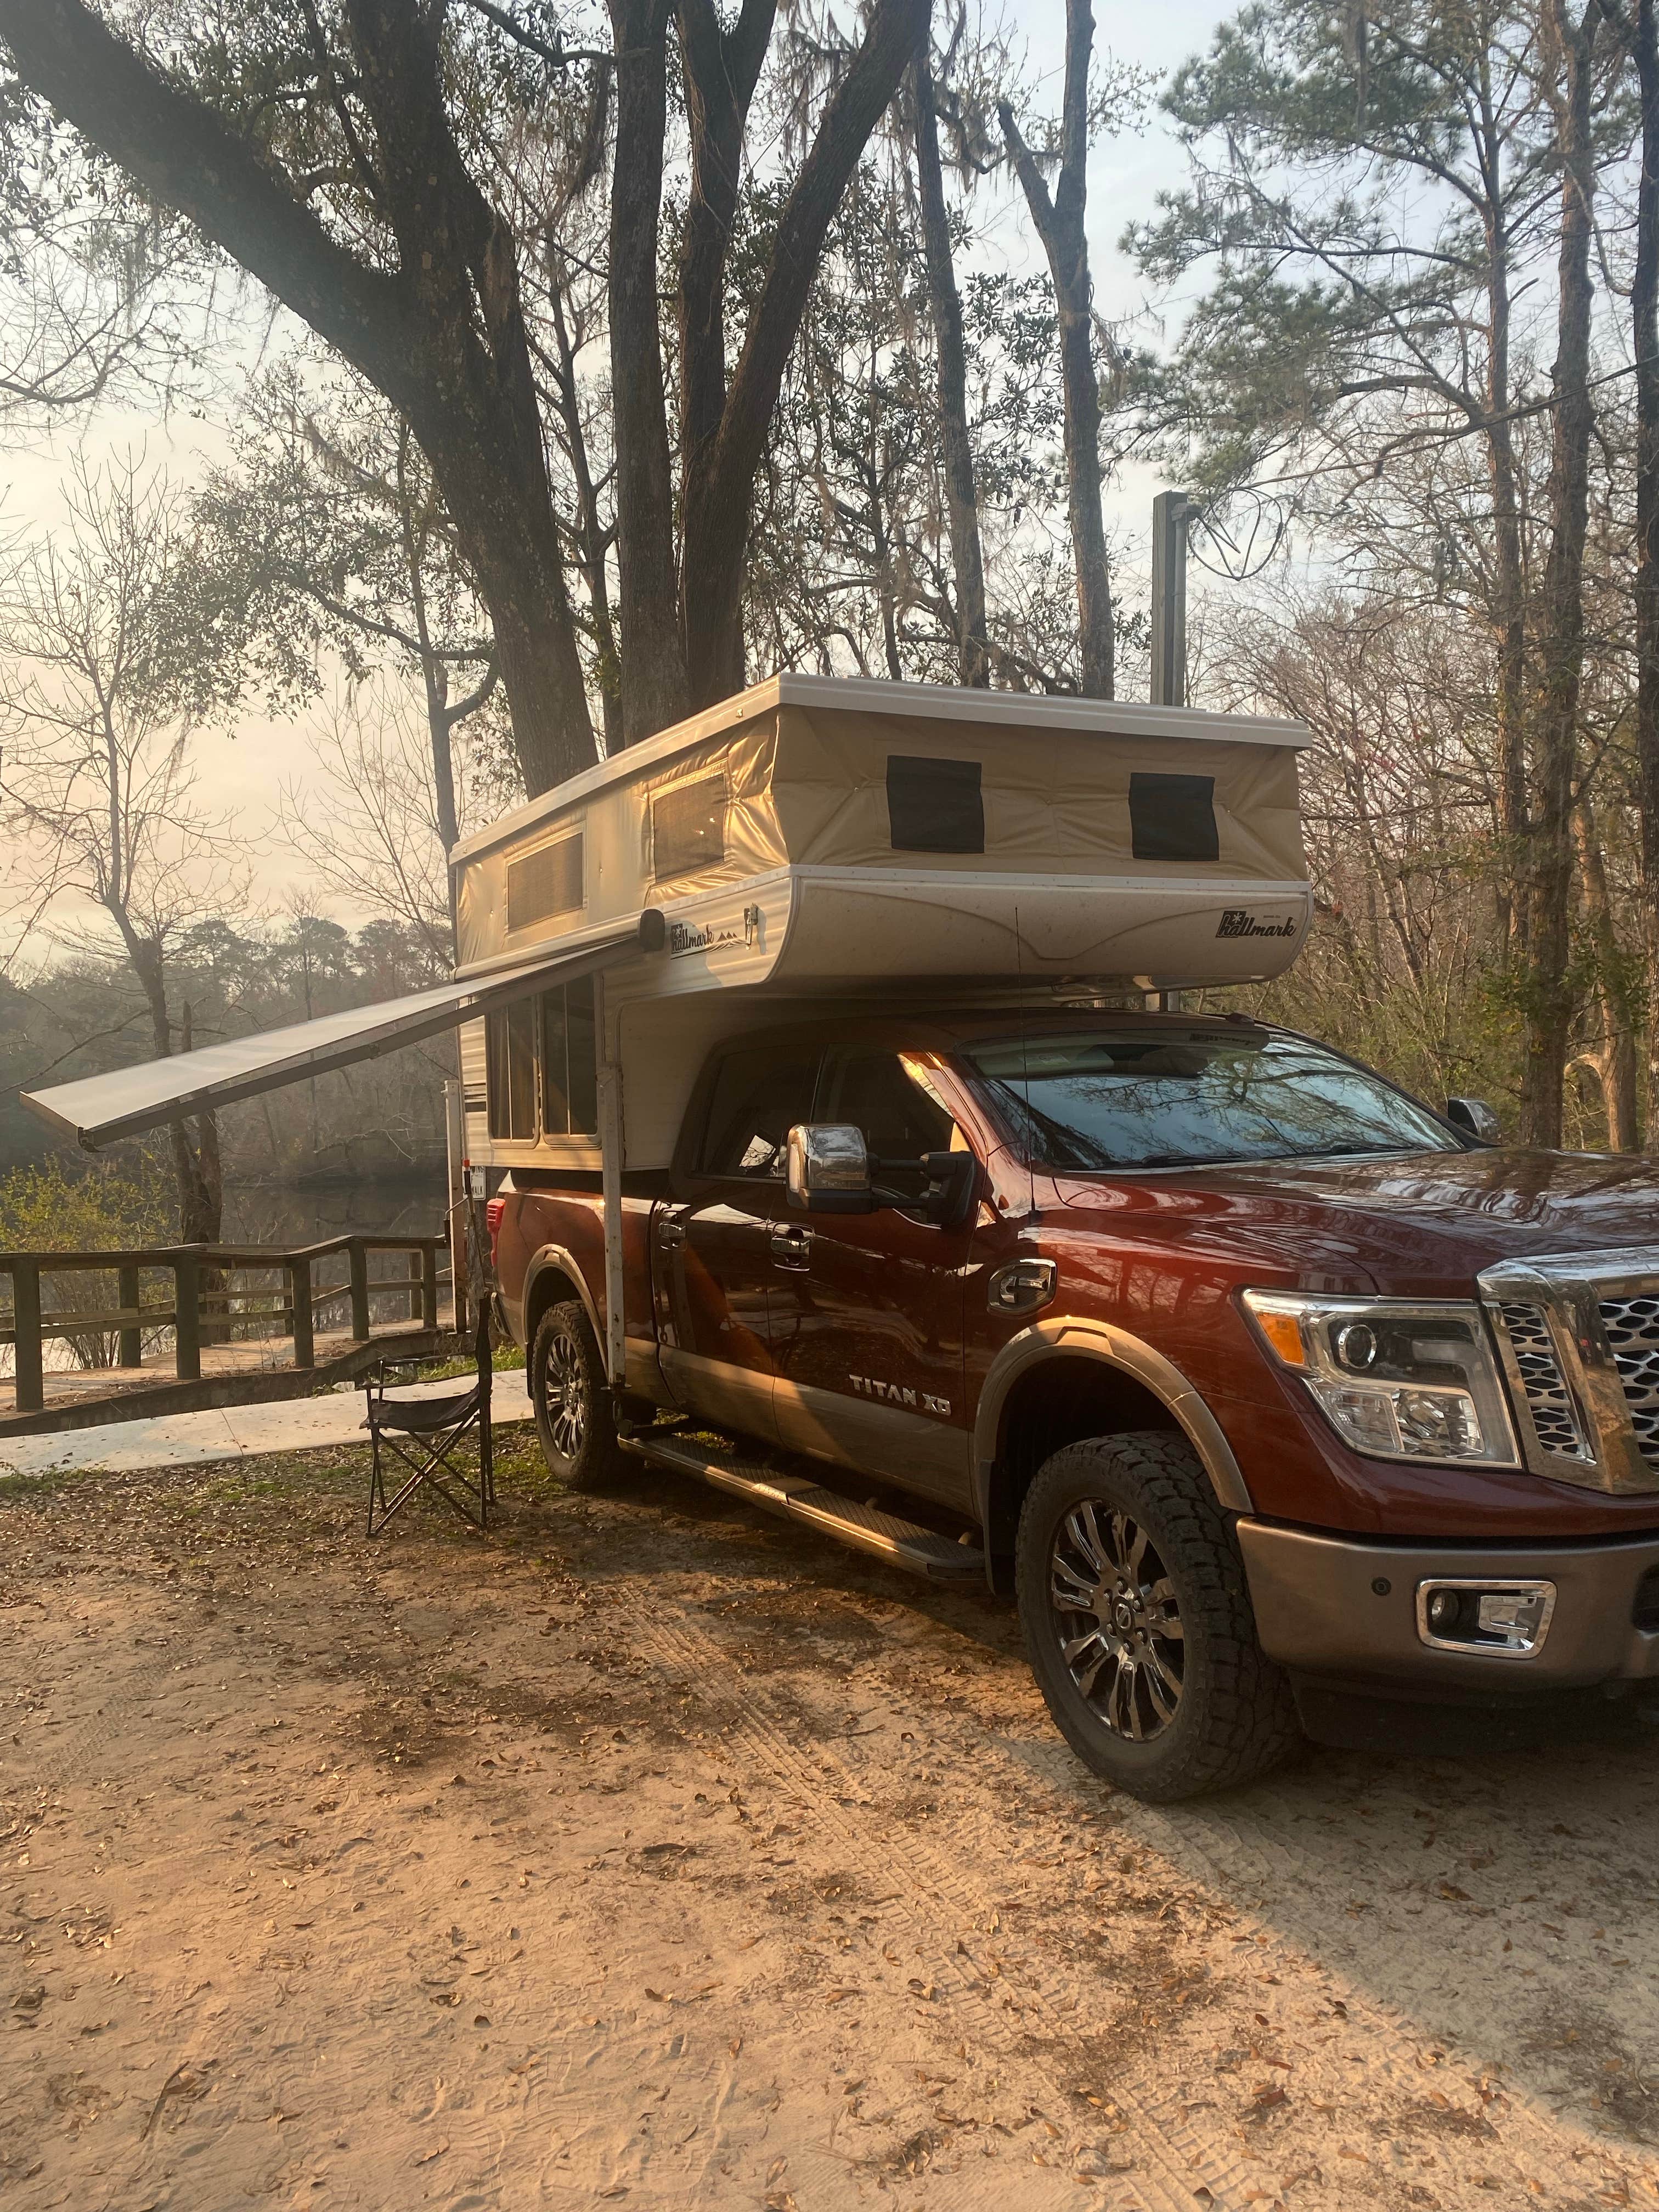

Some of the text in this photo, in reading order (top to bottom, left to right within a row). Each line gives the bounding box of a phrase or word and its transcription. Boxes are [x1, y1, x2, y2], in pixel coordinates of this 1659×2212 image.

[672, 923, 713, 953] hallmark
[1217, 914, 1296, 937] hallmark
[849, 1374, 951, 1416] TITAN XD
